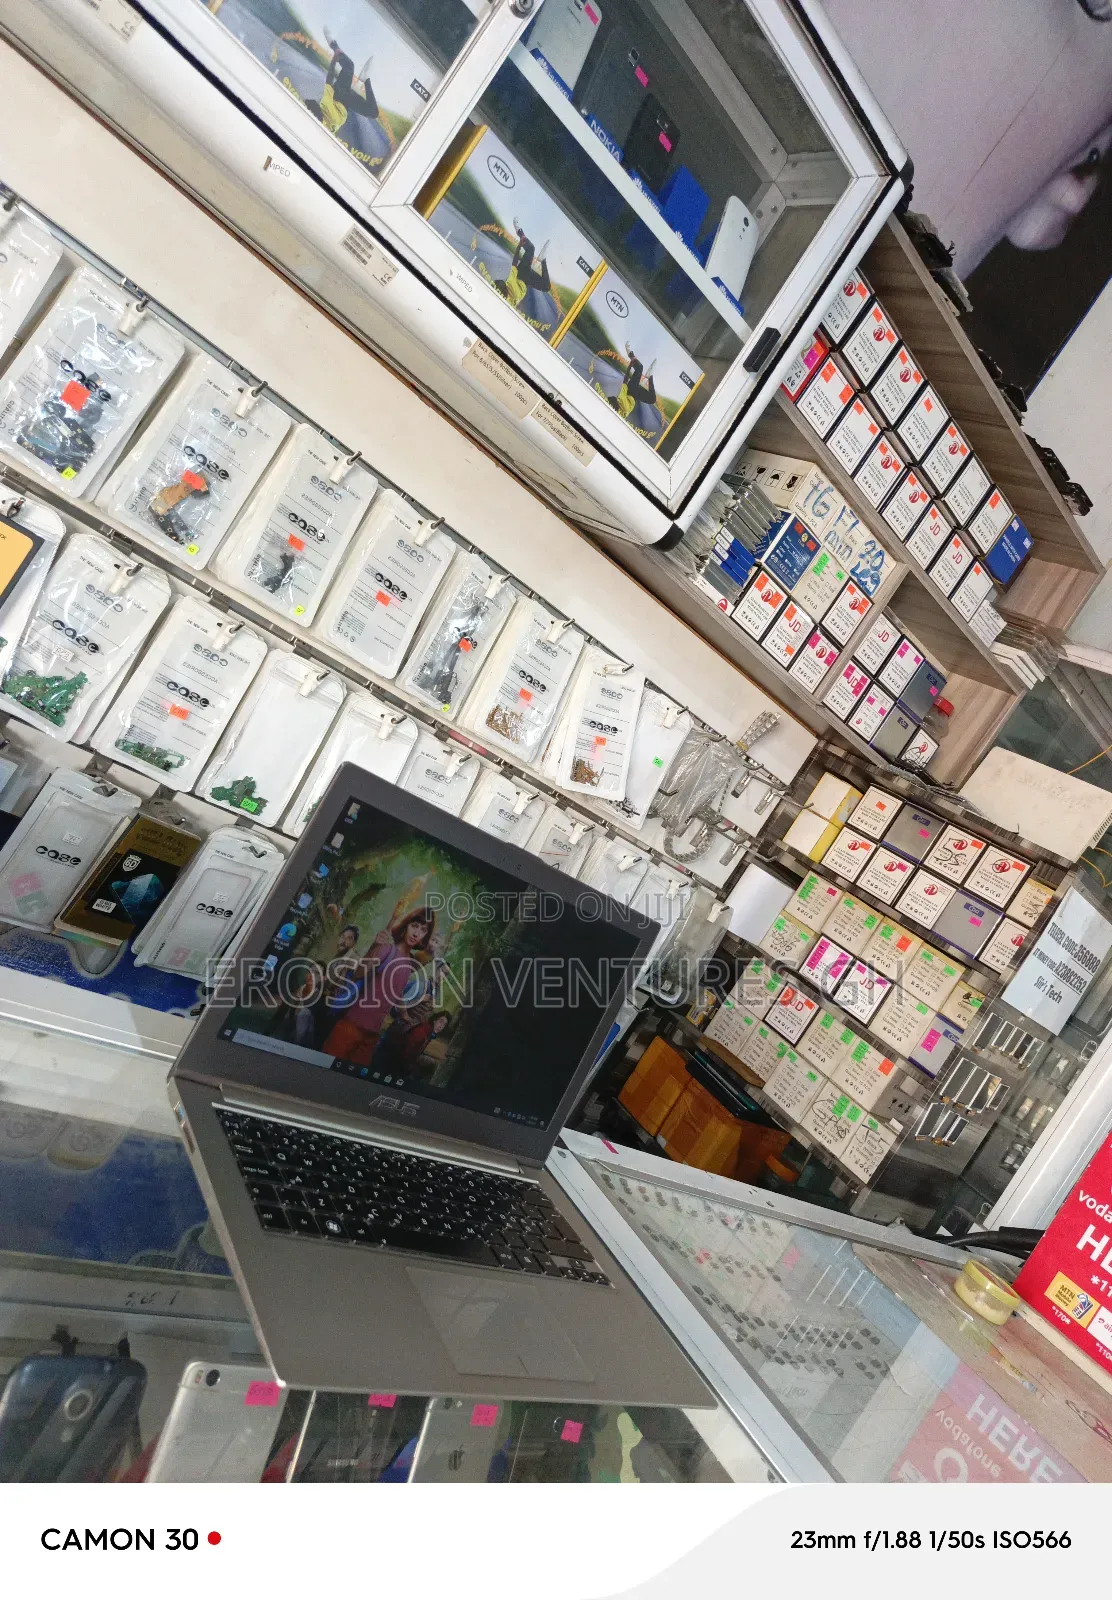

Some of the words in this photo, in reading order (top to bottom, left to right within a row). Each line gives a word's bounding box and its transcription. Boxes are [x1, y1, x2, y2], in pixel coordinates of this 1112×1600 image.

[590, 118, 621, 163] NOKIA
[492, 163, 510, 182] MTN
[610, 296, 625, 313] MTN
[183, 445, 230, 480] case
[929, 522, 941, 536] JD
[952, 552, 963, 565] JD
[375, 573, 408, 601] case
[788, 619, 802, 633] JD
[52, 620, 100, 654] case
[877, 630, 890, 643] JD
[518, 669, 547, 693] case
[167, 681, 210, 708] case
[589, 720, 619, 734] case
[36, 845, 82, 866] case
[196, 902, 233, 918] case
[859, 978, 874, 990] JD
[1046, 984, 1063, 1004] Tech
[368, 1094, 421, 1117] ASUS
[1059, 1284, 1076, 1300] MTN
